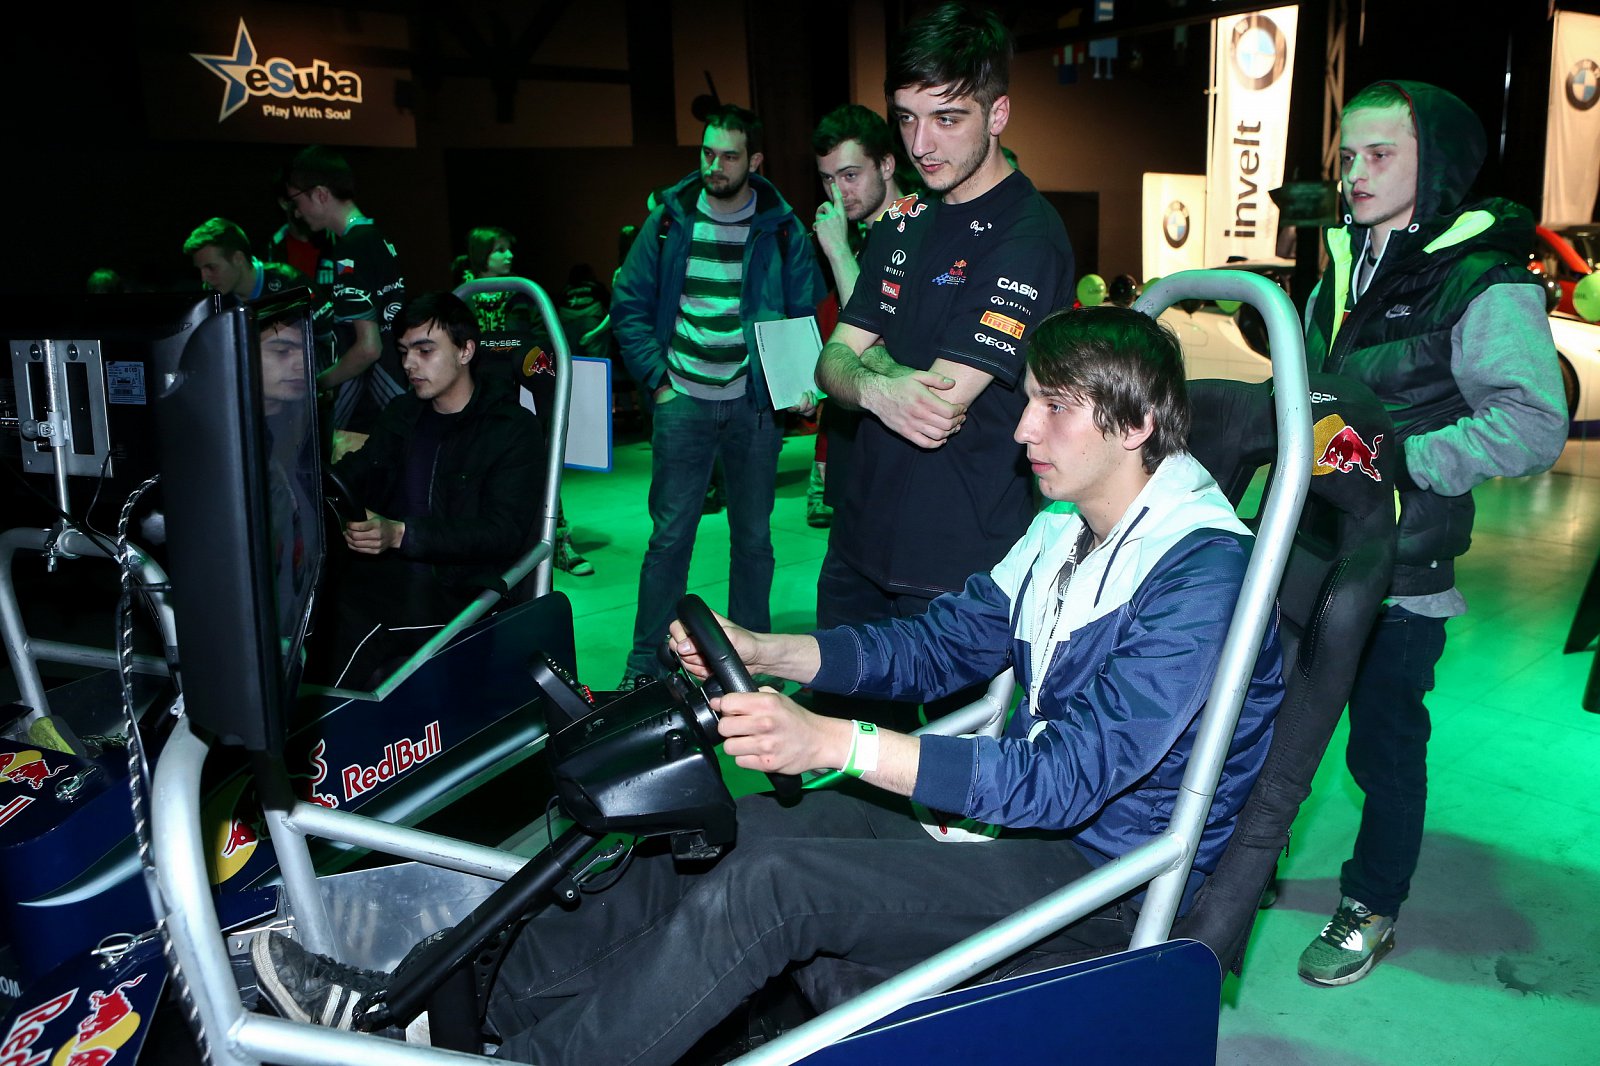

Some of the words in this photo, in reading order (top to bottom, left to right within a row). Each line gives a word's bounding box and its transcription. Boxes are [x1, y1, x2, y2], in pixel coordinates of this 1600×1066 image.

[246, 58, 362, 102] eSuba
[262, 104, 290, 120] Play
[292, 105, 322, 119] With
[325, 108, 352, 120] Soul
[1224, 119, 1261, 238] invelt
[996, 276, 1039, 301] CASIO
[974, 332, 1017, 356] GEOX
